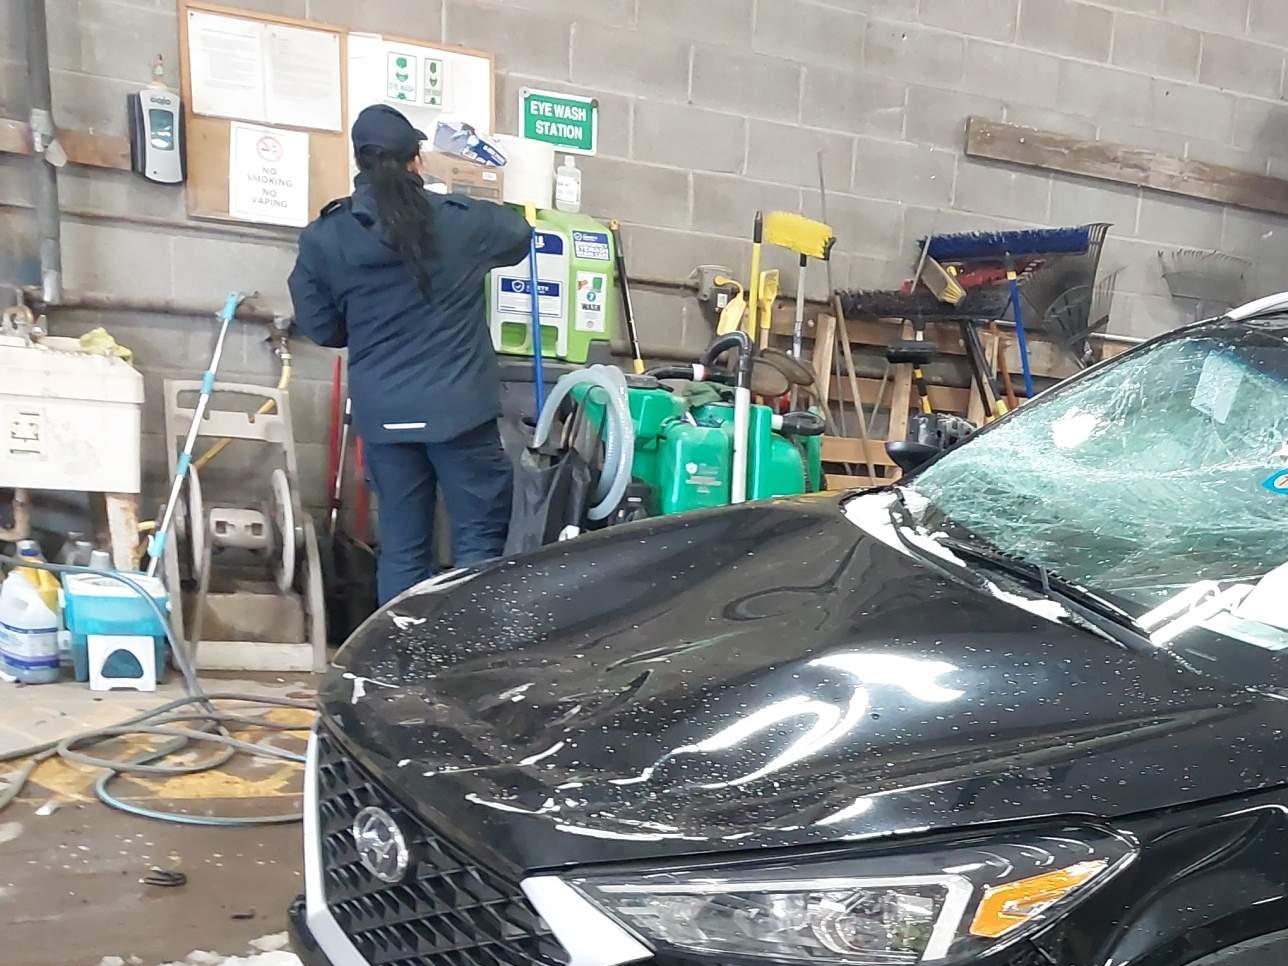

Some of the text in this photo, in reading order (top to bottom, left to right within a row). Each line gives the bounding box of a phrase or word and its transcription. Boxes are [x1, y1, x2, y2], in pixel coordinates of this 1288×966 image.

[530, 100, 587, 122] EYE WASH
[535, 120, 583, 140] STATION
[262, 167, 277, 175] NO
[247, 173, 293, 187] SMOKING
[262, 188, 277, 197] NO
[251, 197, 288, 208] VAPING
